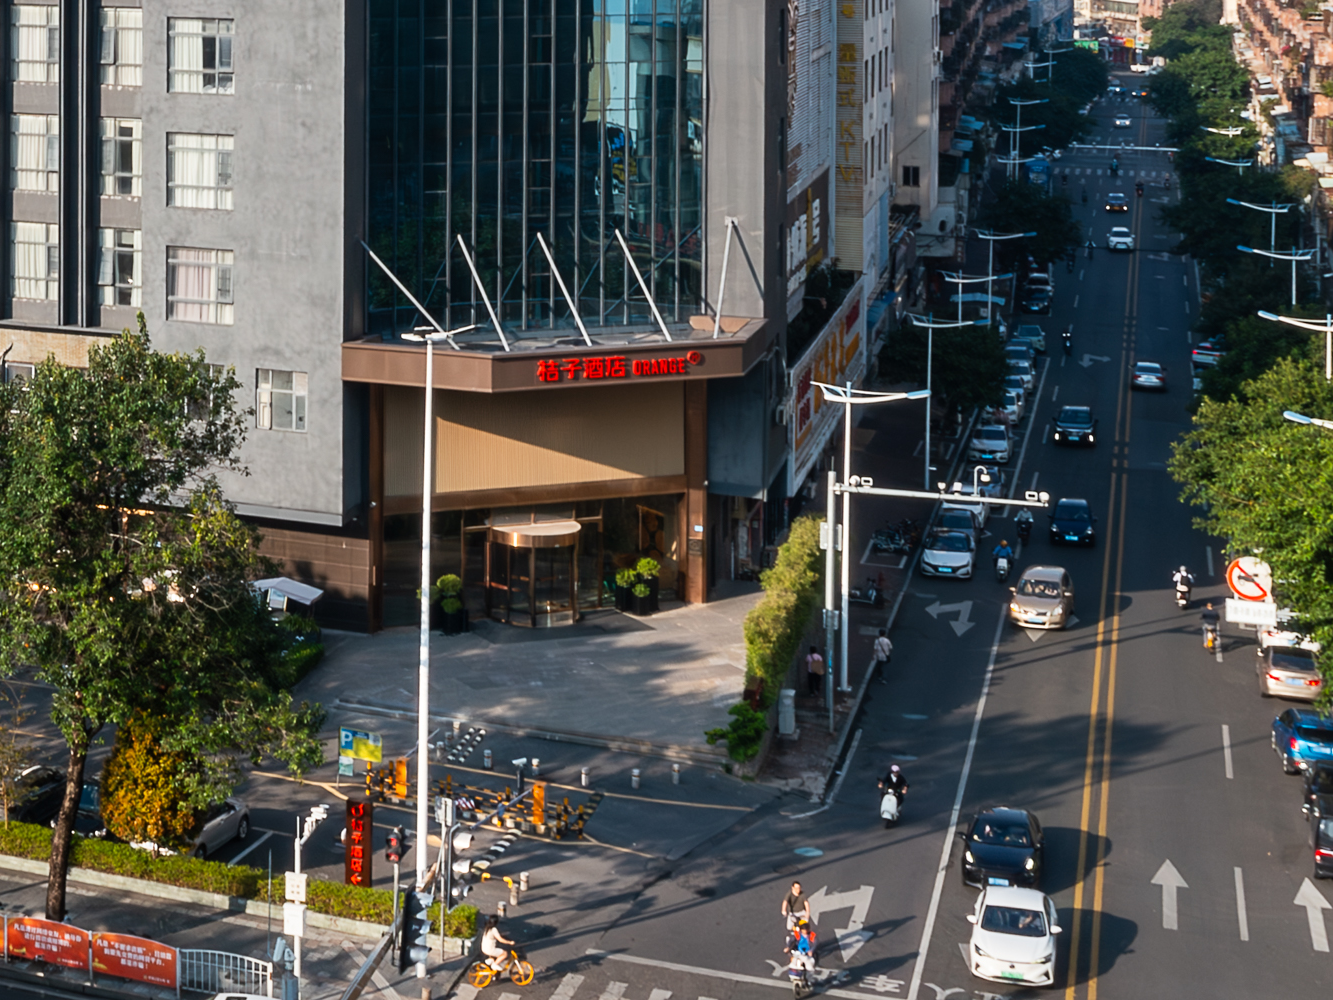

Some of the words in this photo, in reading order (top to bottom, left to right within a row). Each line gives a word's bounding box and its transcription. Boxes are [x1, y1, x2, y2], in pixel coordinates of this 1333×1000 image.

[536, 355, 626, 382] 桔子酒店
[632, 357, 686, 376] ORANGE
[341, 730, 353, 747] P
[350, 818, 364, 873] 桔子酒店
